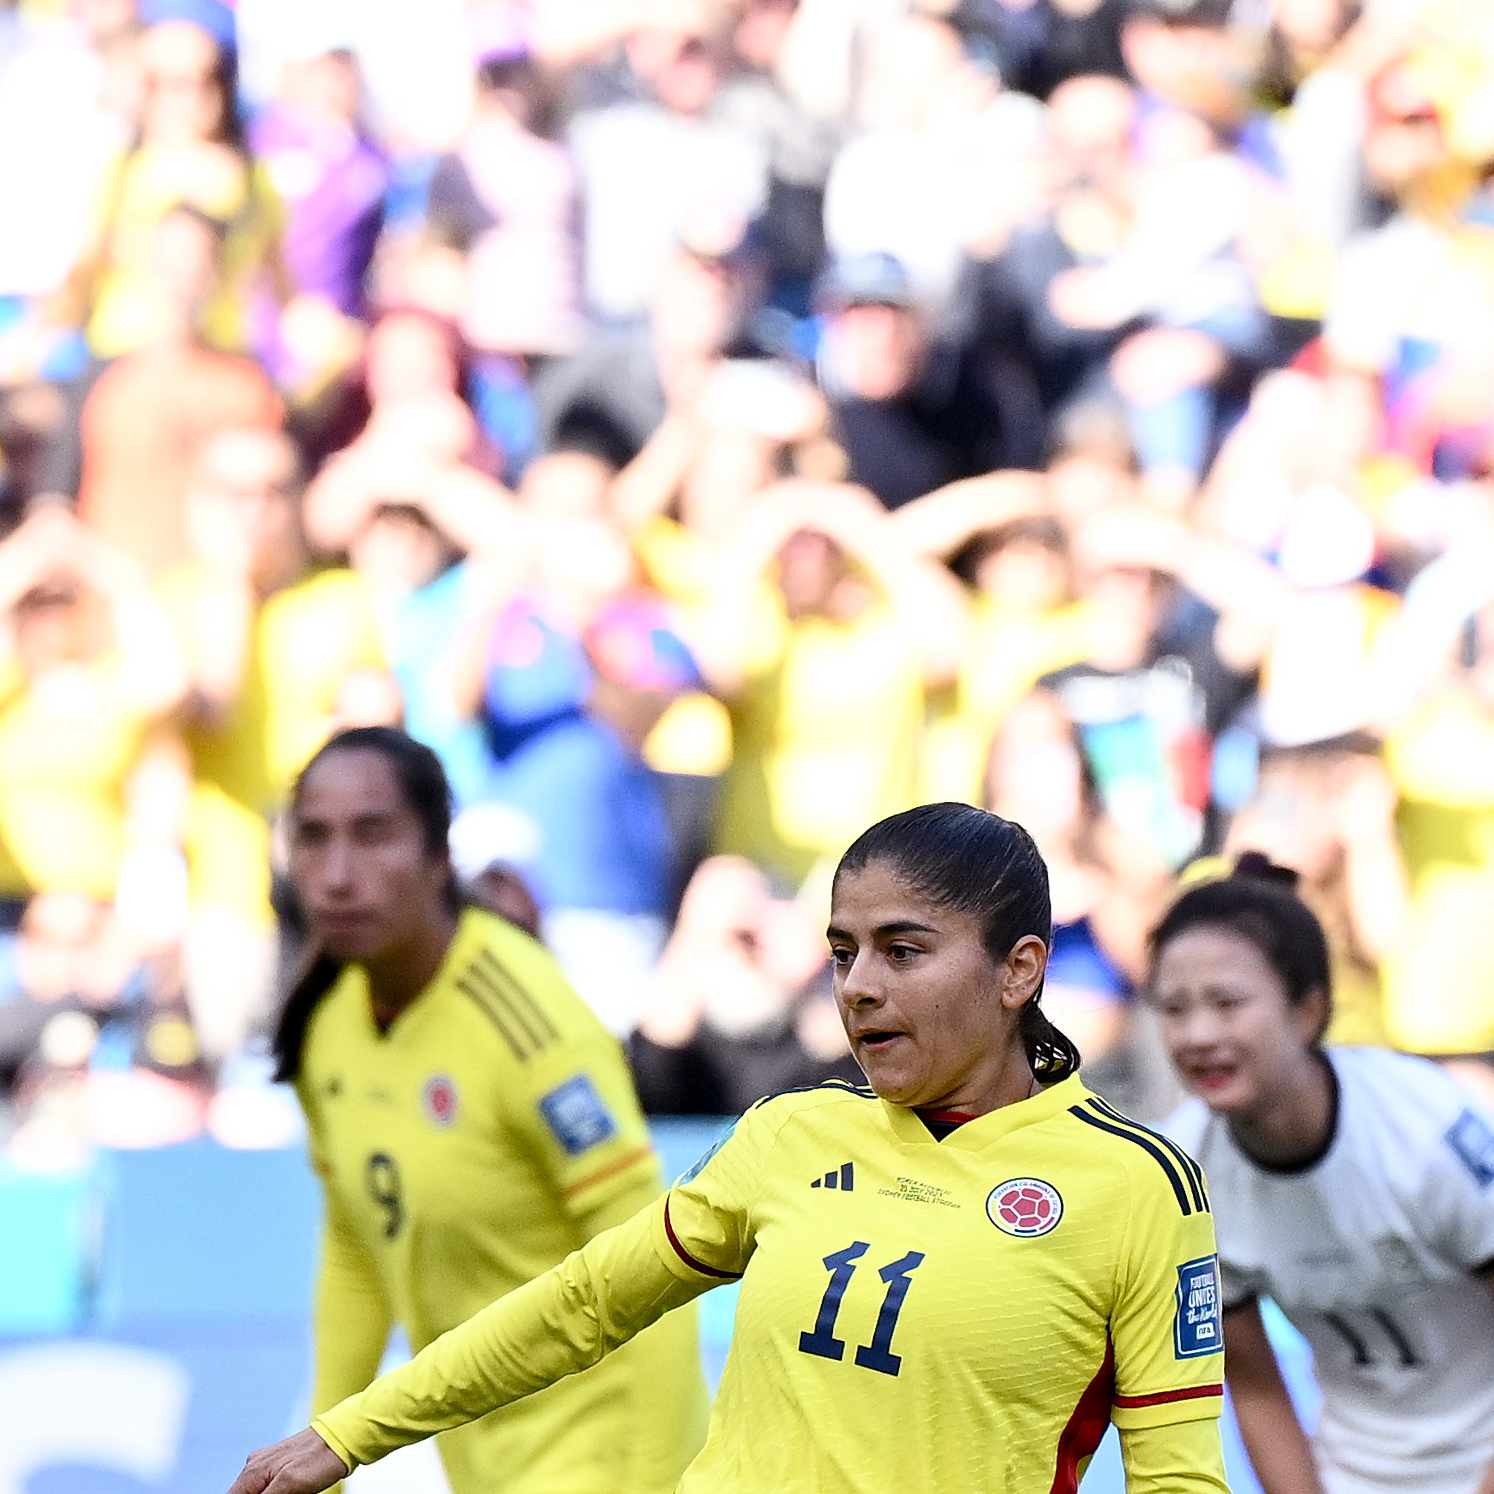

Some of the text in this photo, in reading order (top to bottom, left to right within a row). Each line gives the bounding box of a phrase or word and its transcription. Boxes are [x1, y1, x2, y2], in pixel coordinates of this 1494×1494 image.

[365, 1151, 406, 1238] 9
[798, 1241, 926, 1377] 11
[1188, 1286, 1216, 1308] UNITES
[1320, 1304, 1421, 1368] 11
